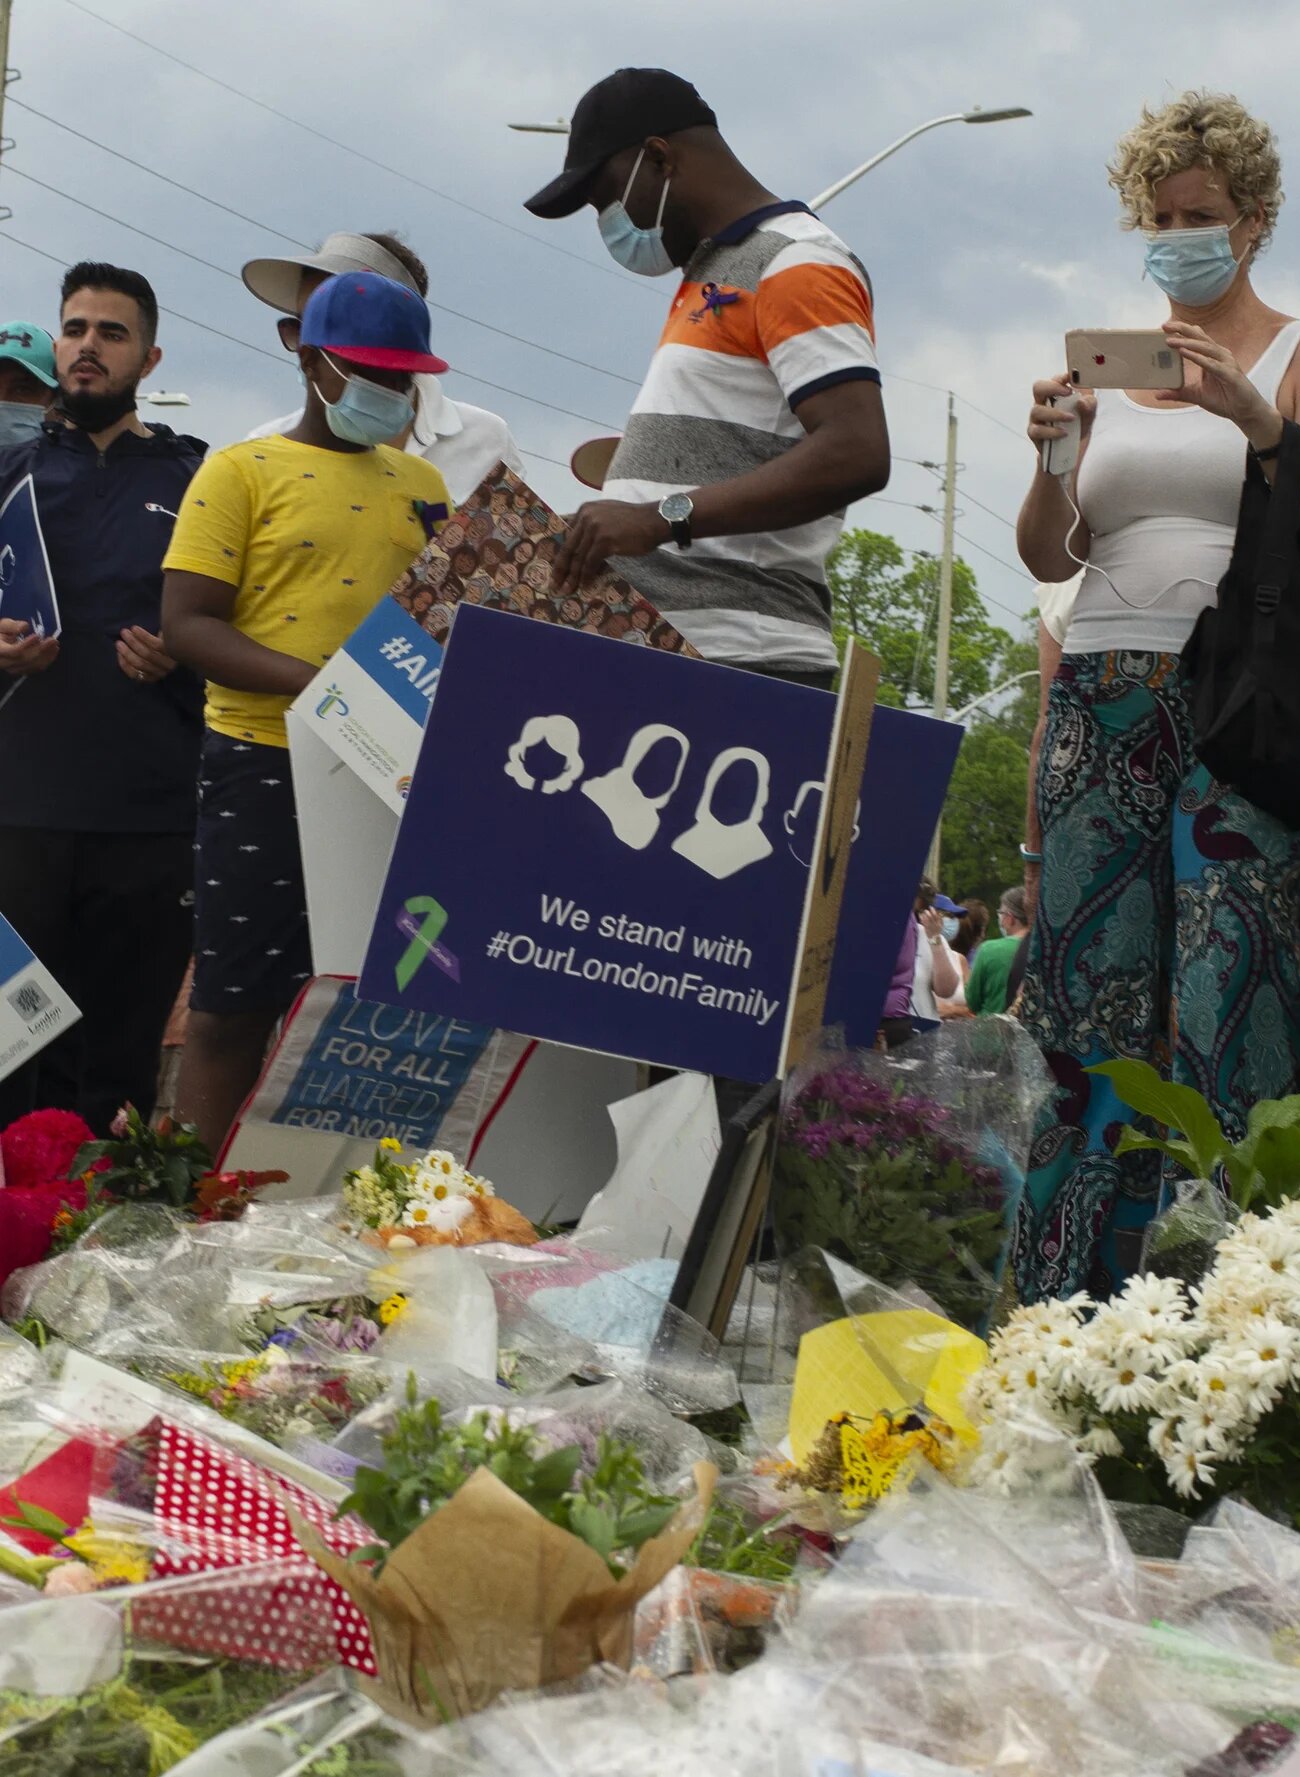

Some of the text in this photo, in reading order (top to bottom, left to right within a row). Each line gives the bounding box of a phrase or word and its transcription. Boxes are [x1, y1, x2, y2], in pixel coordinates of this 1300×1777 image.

[541, 894, 753, 970] We stand with
[486, 930, 780, 1026] #OurLondonFamily
[320, 1037, 451, 1087] FOR ALL
[284, 1107, 341, 1132] FOR
[301, 1069, 440, 1121] HATRED
